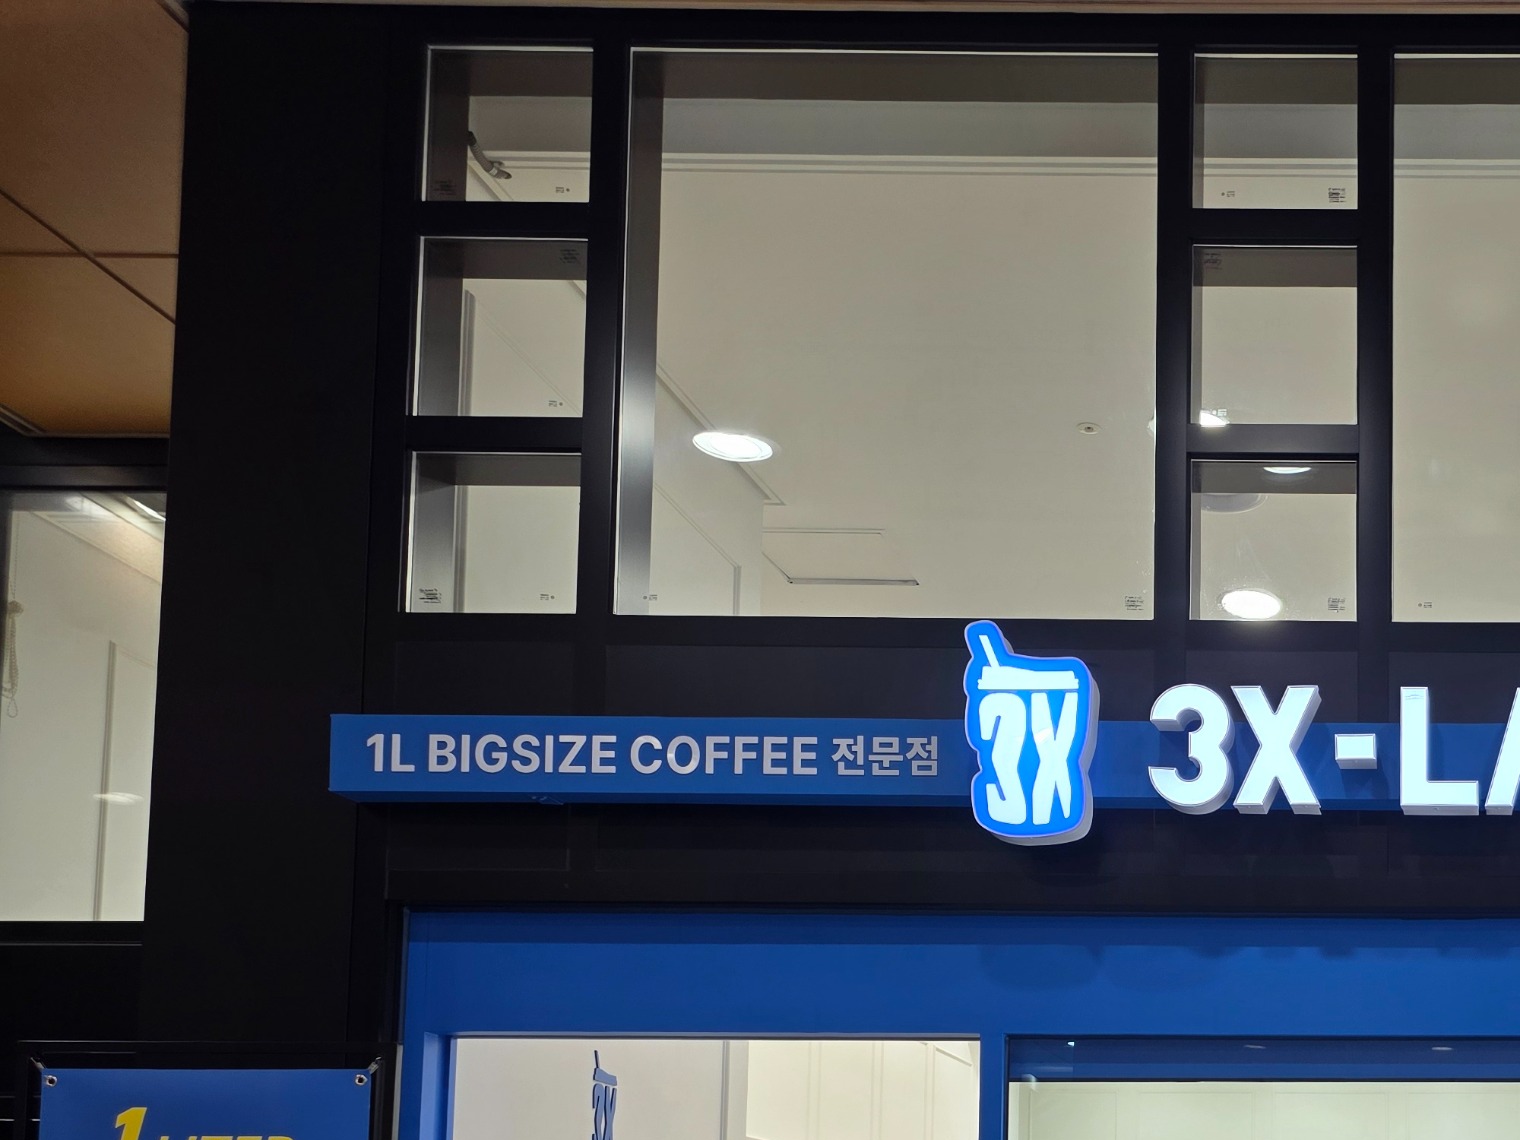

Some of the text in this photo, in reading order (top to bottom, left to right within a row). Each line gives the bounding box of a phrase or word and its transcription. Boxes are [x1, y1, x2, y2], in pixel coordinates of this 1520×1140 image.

[366, 732, 939, 778] 1L BIGSIZE COFFEE 전문점
